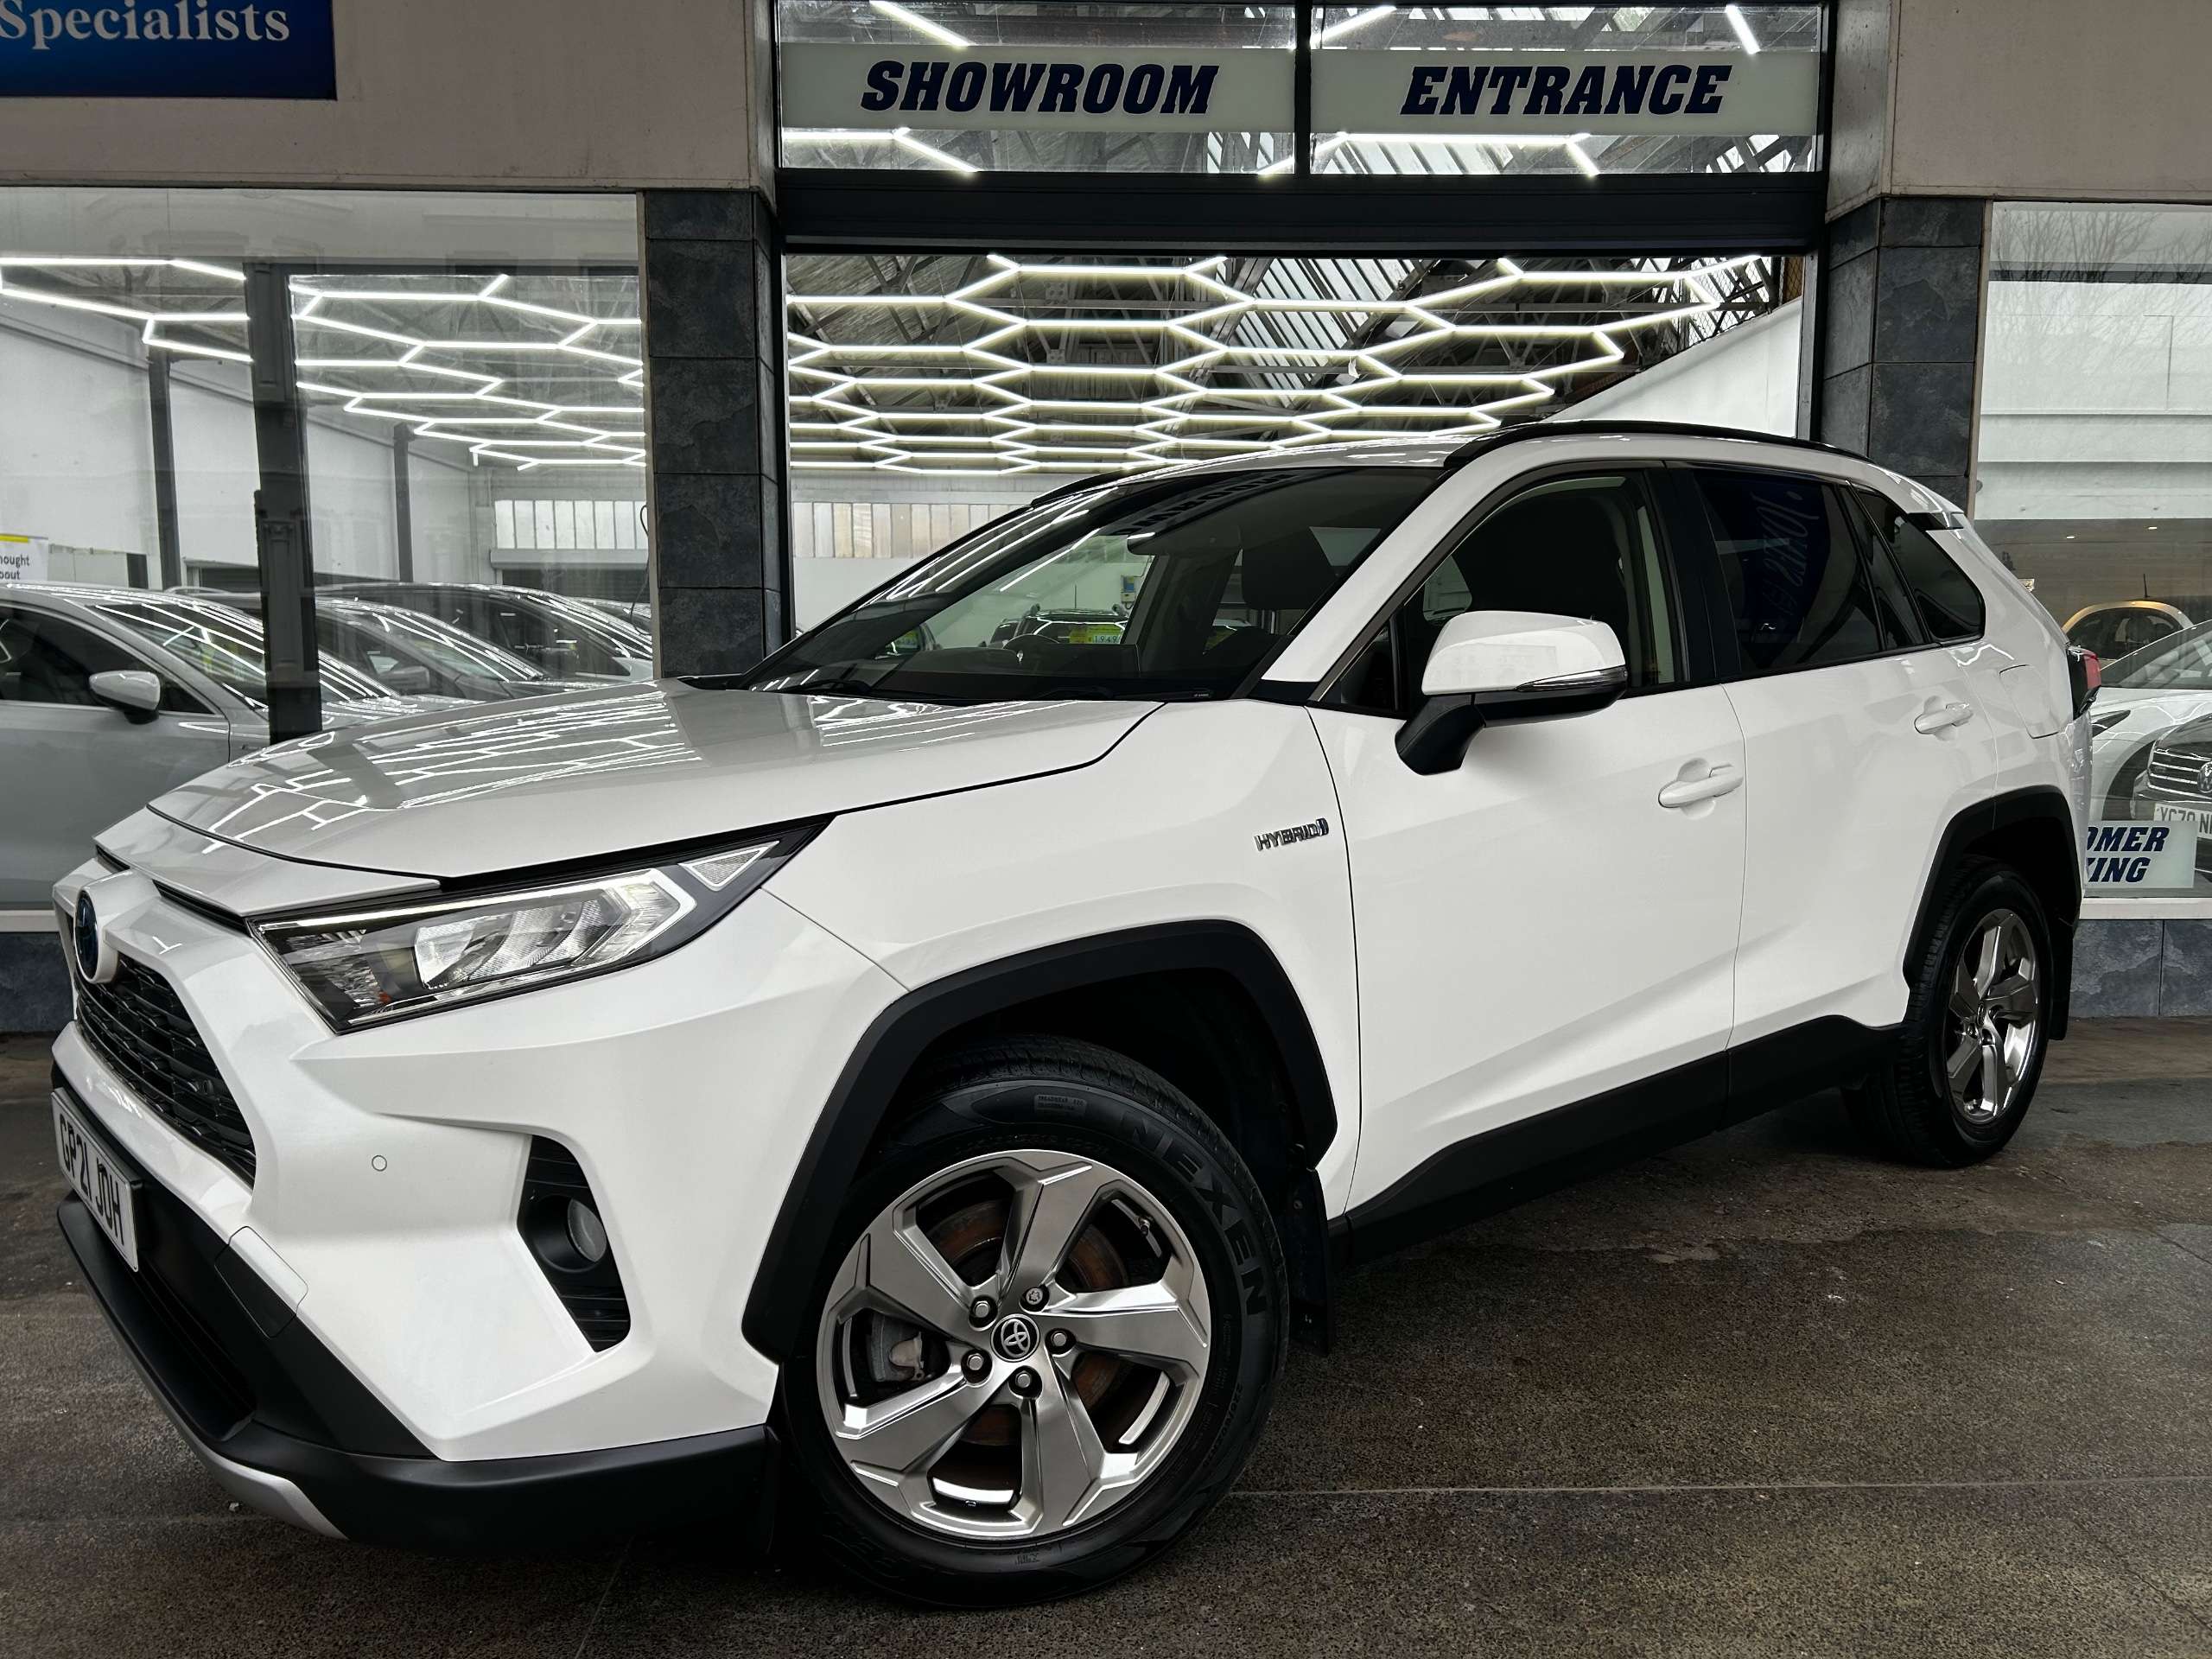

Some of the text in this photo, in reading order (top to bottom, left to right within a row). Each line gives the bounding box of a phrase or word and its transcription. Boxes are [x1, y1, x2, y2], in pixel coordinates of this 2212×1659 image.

[0, 0, 290, 50] Specialists
[861, 60, 1219, 114] SHOWROOM
[1400, 65, 1732, 115] ENTRANCE
[1254, 823, 1318, 852] HYBRID
[60, 1113, 124, 1245] GP21 JOH
[1120, 1109, 1268, 1316] NEXEN
